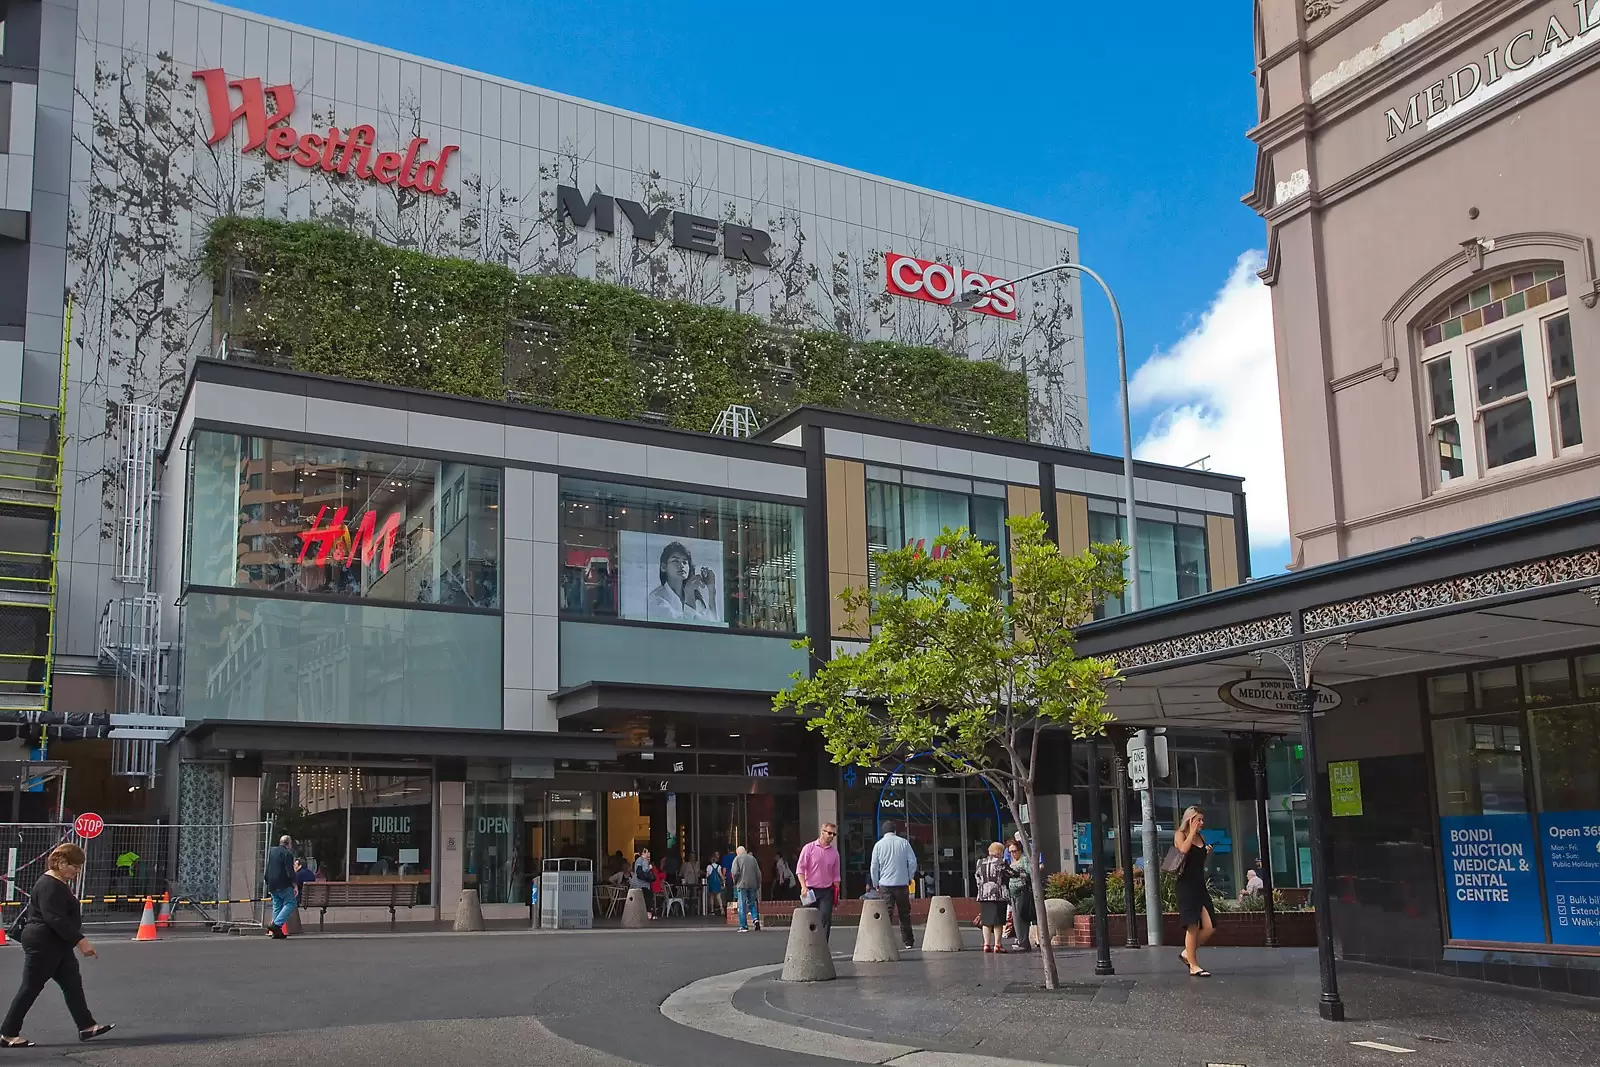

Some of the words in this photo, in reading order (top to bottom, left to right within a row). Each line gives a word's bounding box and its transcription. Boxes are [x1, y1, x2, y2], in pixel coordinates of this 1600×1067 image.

[1386, 0, 1600, 142] MEDICAL
[192, 68, 459, 196] Westfield
[557, 185, 772, 267] MYER
[891, 257, 1015, 313] coles
[296, 504, 401, 575] H&M
[1260, 681, 1280, 689] BONDI
[1239, 688, 1285, 701] MEDICAL
[1133, 751, 1145, 762] ONE
[747, 762, 769, 776] VANS
[1133, 763, 1146, 774] WAY
[1333, 766, 1353, 779] FLU
[76, 818, 102, 833] STOP
[371, 816, 411, 833] PUBLIC
[478, 816, 511, 834] OPEN
[1450, 829, 1493, 842] BONDI
[1549, 826, 1581, 840] Open
[1452, 843, 1523, 857] JUNCTION
[1552, 852, 1561, 860] Sat
[1453, 858, 1516, 872] MEDICAL
[1519, 858, 1530, 872] &
[1455, 873, 1508, 887] DENTAL
[1456, 888, 1509, 902] CENTRE
[1570, 895, 1588, 905] Bulk
[1571, 906, 1600, 916] Extend
